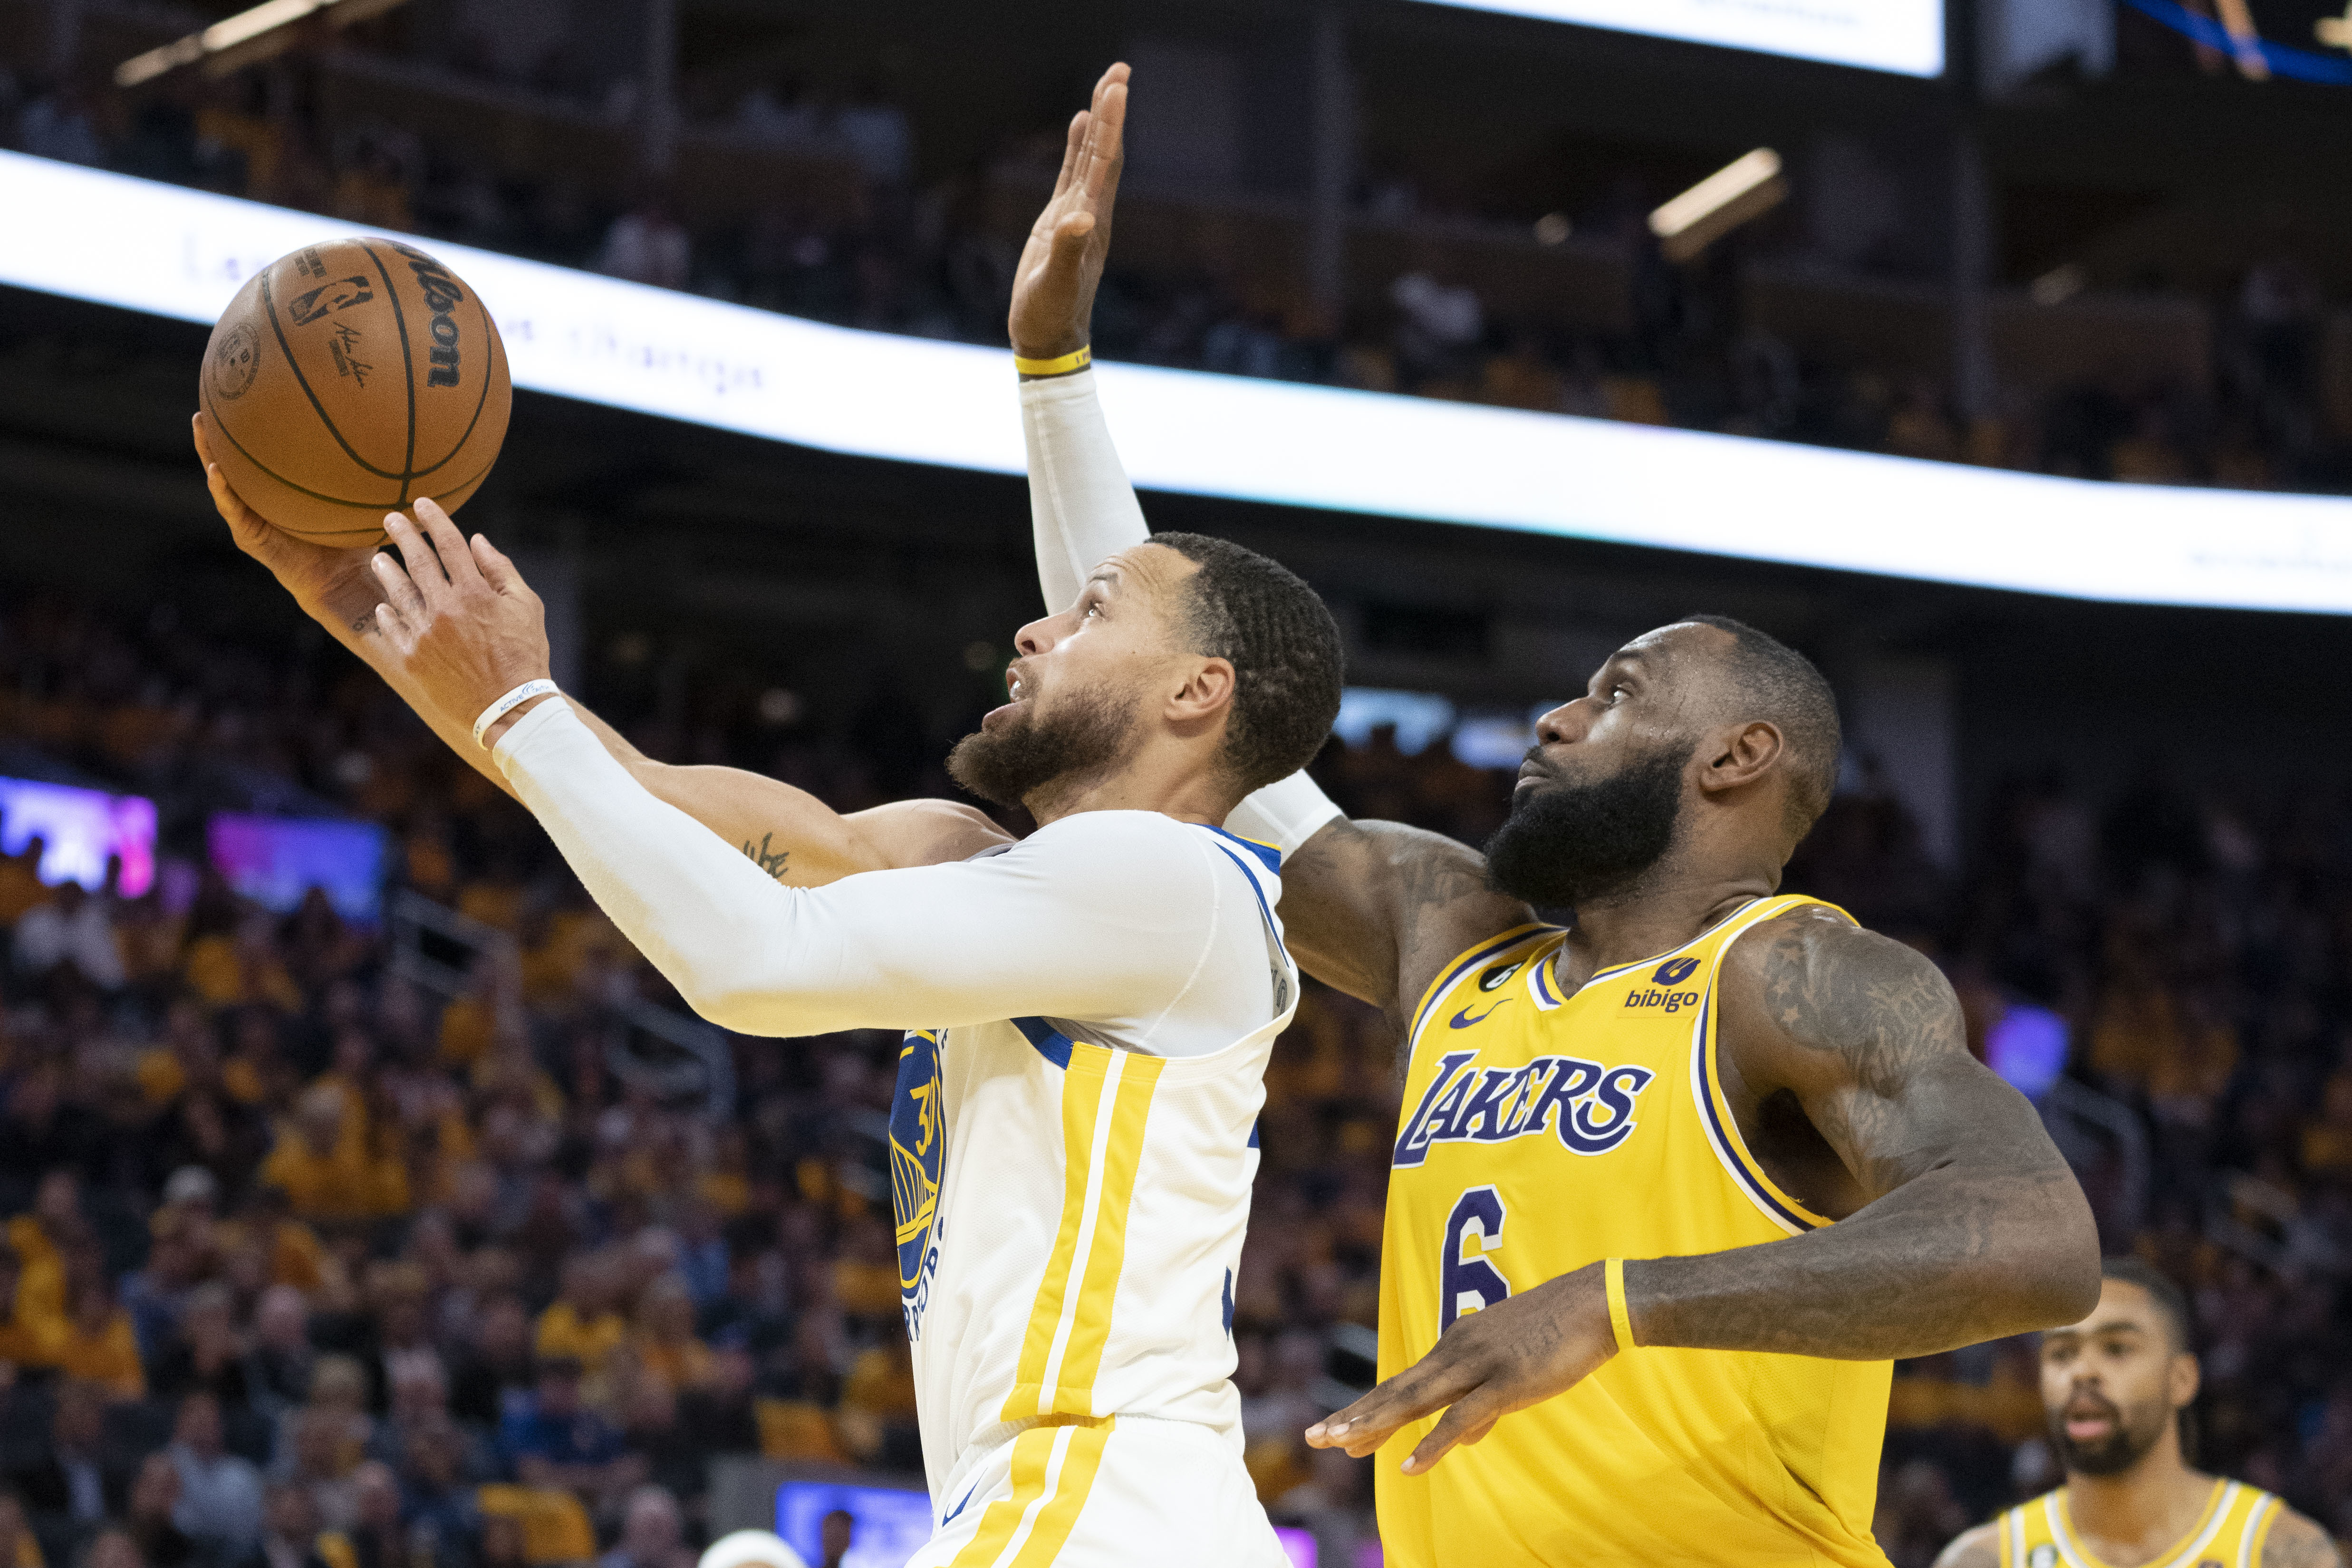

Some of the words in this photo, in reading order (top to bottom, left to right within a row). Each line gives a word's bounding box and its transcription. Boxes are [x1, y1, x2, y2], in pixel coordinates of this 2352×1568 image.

[500, 694, 524, 712] ACTIVE
[1486, 963, 1522, 988] 6
[1625, 989, 1699, 1013] bibigo
[909, 1076, 935, 1156] 30
[1392, 1049, 1657, 1169] LAKERS
[1437, 1183, 1512, 1341] 6
